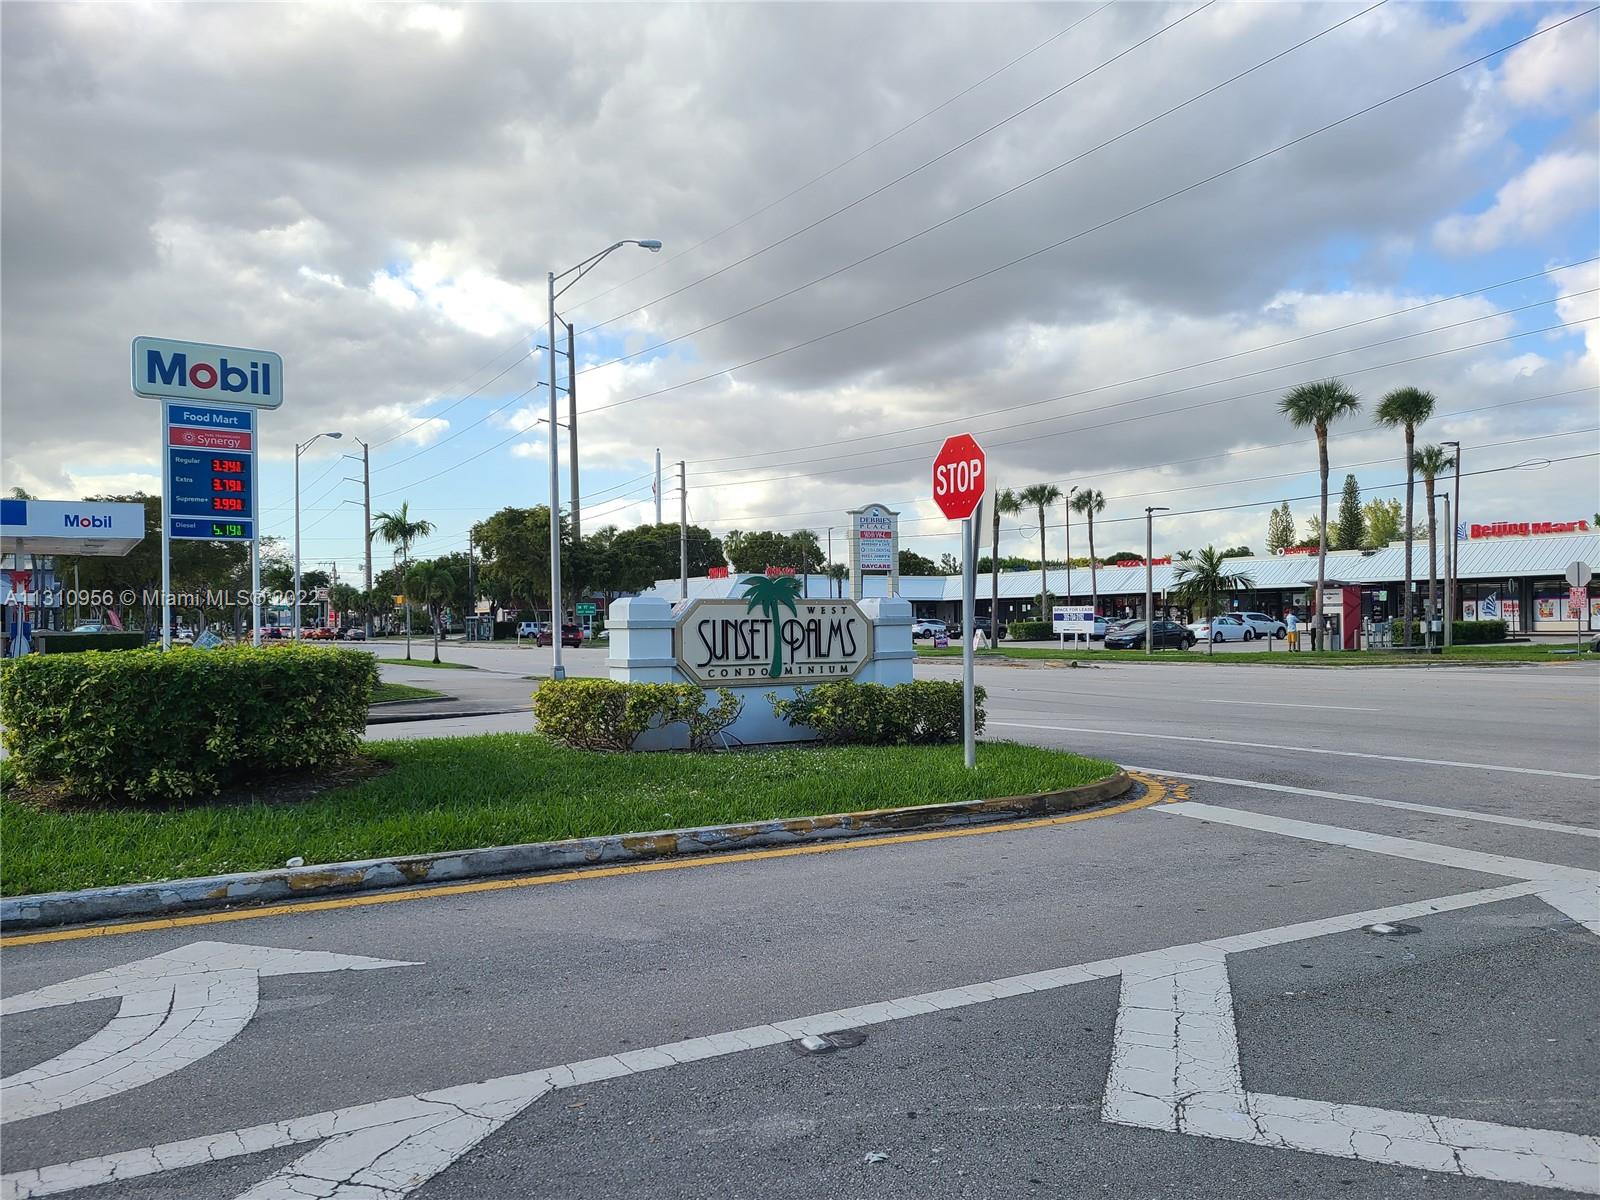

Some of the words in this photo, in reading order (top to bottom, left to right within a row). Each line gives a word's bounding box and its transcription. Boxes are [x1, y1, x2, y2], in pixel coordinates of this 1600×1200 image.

[147, 350, 271, 395] Mobil
[183, 411, 210, 422] Food
[212, 414, 239, 425] Mart
[197, 434, 241, 448] Synergy
[175, 456, 201, 465] Regular
[175, 475, 193, 483] Extra
[936, 459, 982, 496] STOP
[64, 514, 112, 529] Mobil
[175, 521, 196, 529] Diesel
[1471, 522, 1530, 539] Beijing
[1532, 520, 1589, 535] Mart
[807, 606, 848, 615] WEST
[697, 618, 773, 667] SUNSET
[781, 618, 857, 665] PALMS
